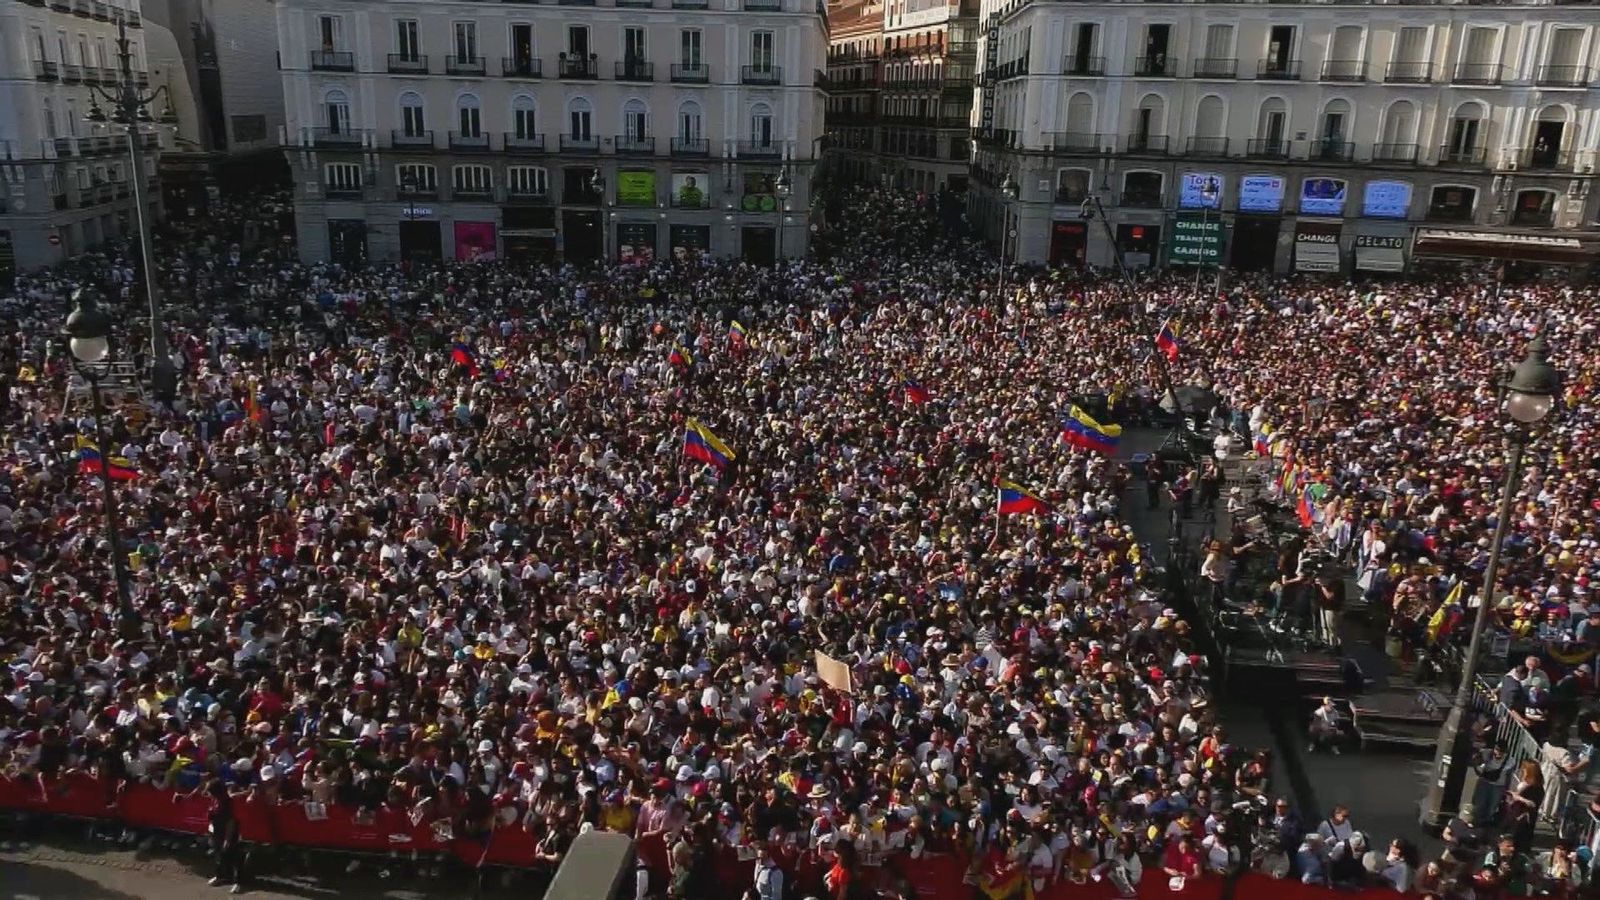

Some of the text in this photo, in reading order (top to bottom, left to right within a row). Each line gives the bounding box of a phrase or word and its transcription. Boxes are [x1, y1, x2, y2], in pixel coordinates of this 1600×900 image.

[1176, 221, 1219, 231] CHANGE
[1297, 233, 1337, 243] CHANGE
[1357, 236, 1403, 248] GELATO
